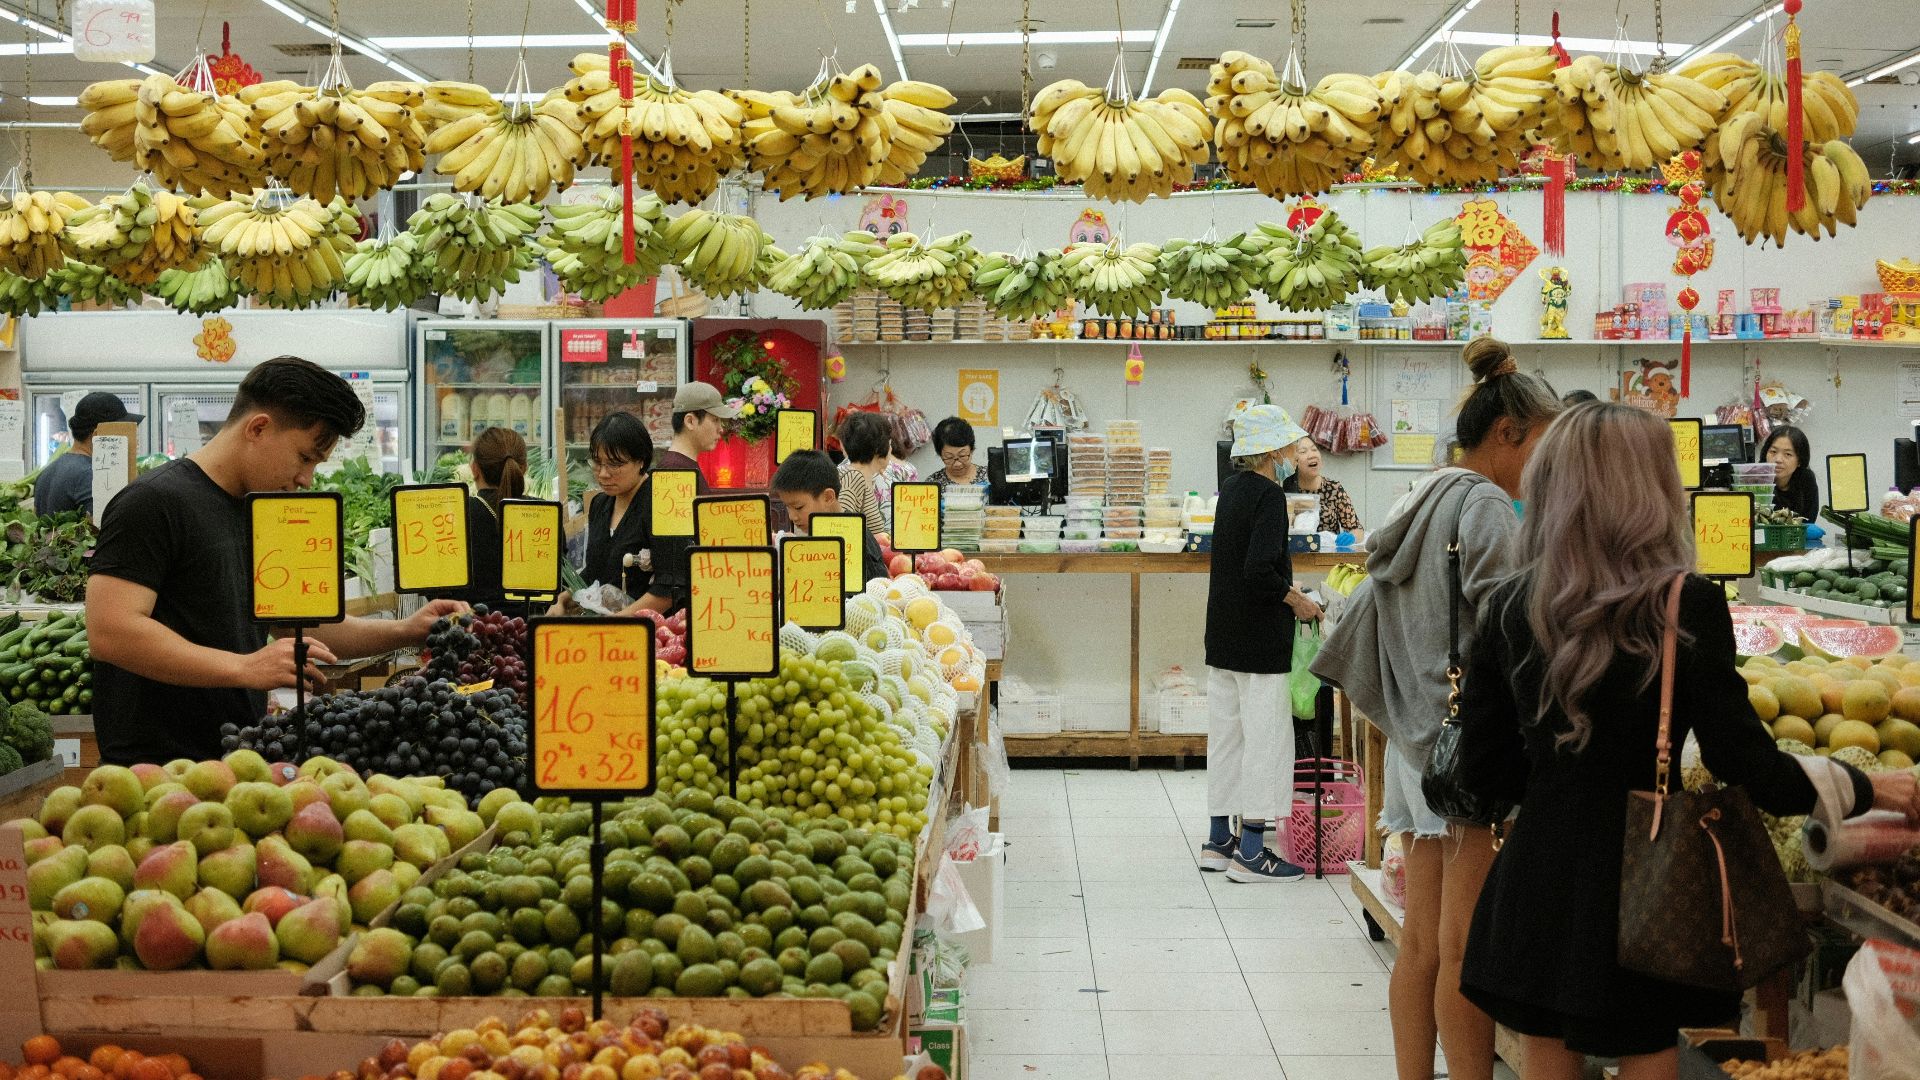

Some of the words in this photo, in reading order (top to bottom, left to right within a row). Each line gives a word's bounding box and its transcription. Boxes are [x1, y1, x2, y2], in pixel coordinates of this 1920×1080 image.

[85, 8, 113, 47] 6
[120, 12, 141, 23] 99
[676, 484, 693, 500] 99
[710, 502, 756, 518] Grapes
[901, 510, 913, 531] 7
[922, 507, 936, 515] 99
[921, 523, 935, 531] KG
[403, 521, 428, 556] 13
[432, 513, 455, 535] 99
[1699, 524, 1724, 544] 13
[436, 543, 459, 557] KG
[505, 528, 525, 562] 11
[531, 527, 551, 542] 99
[790, 543, 838, 563] Guava
[1731, 543, 1750, 553] KG
[255, 549, 290, 590] 6
[302, 537, 333, 552] 99
[537, 550, 550, 560] KG
[301, 580, 330, 595] KG
[788, 578, 814, 605] 12
[823, 570, 841, 582] 99
[823, 595, 840, 604] KG
[697, 596, 736, 632] 15
[748, 589, 773, 605] 99
[747, 629, 773, 643] KG
[539, 685, 595, 735] 16
[609, 676, 640, 694] 99
[609, 732, 645, 751] KG
[1260, 859, 1279, 874] N
[928, 1042, 951, 1050] Class
